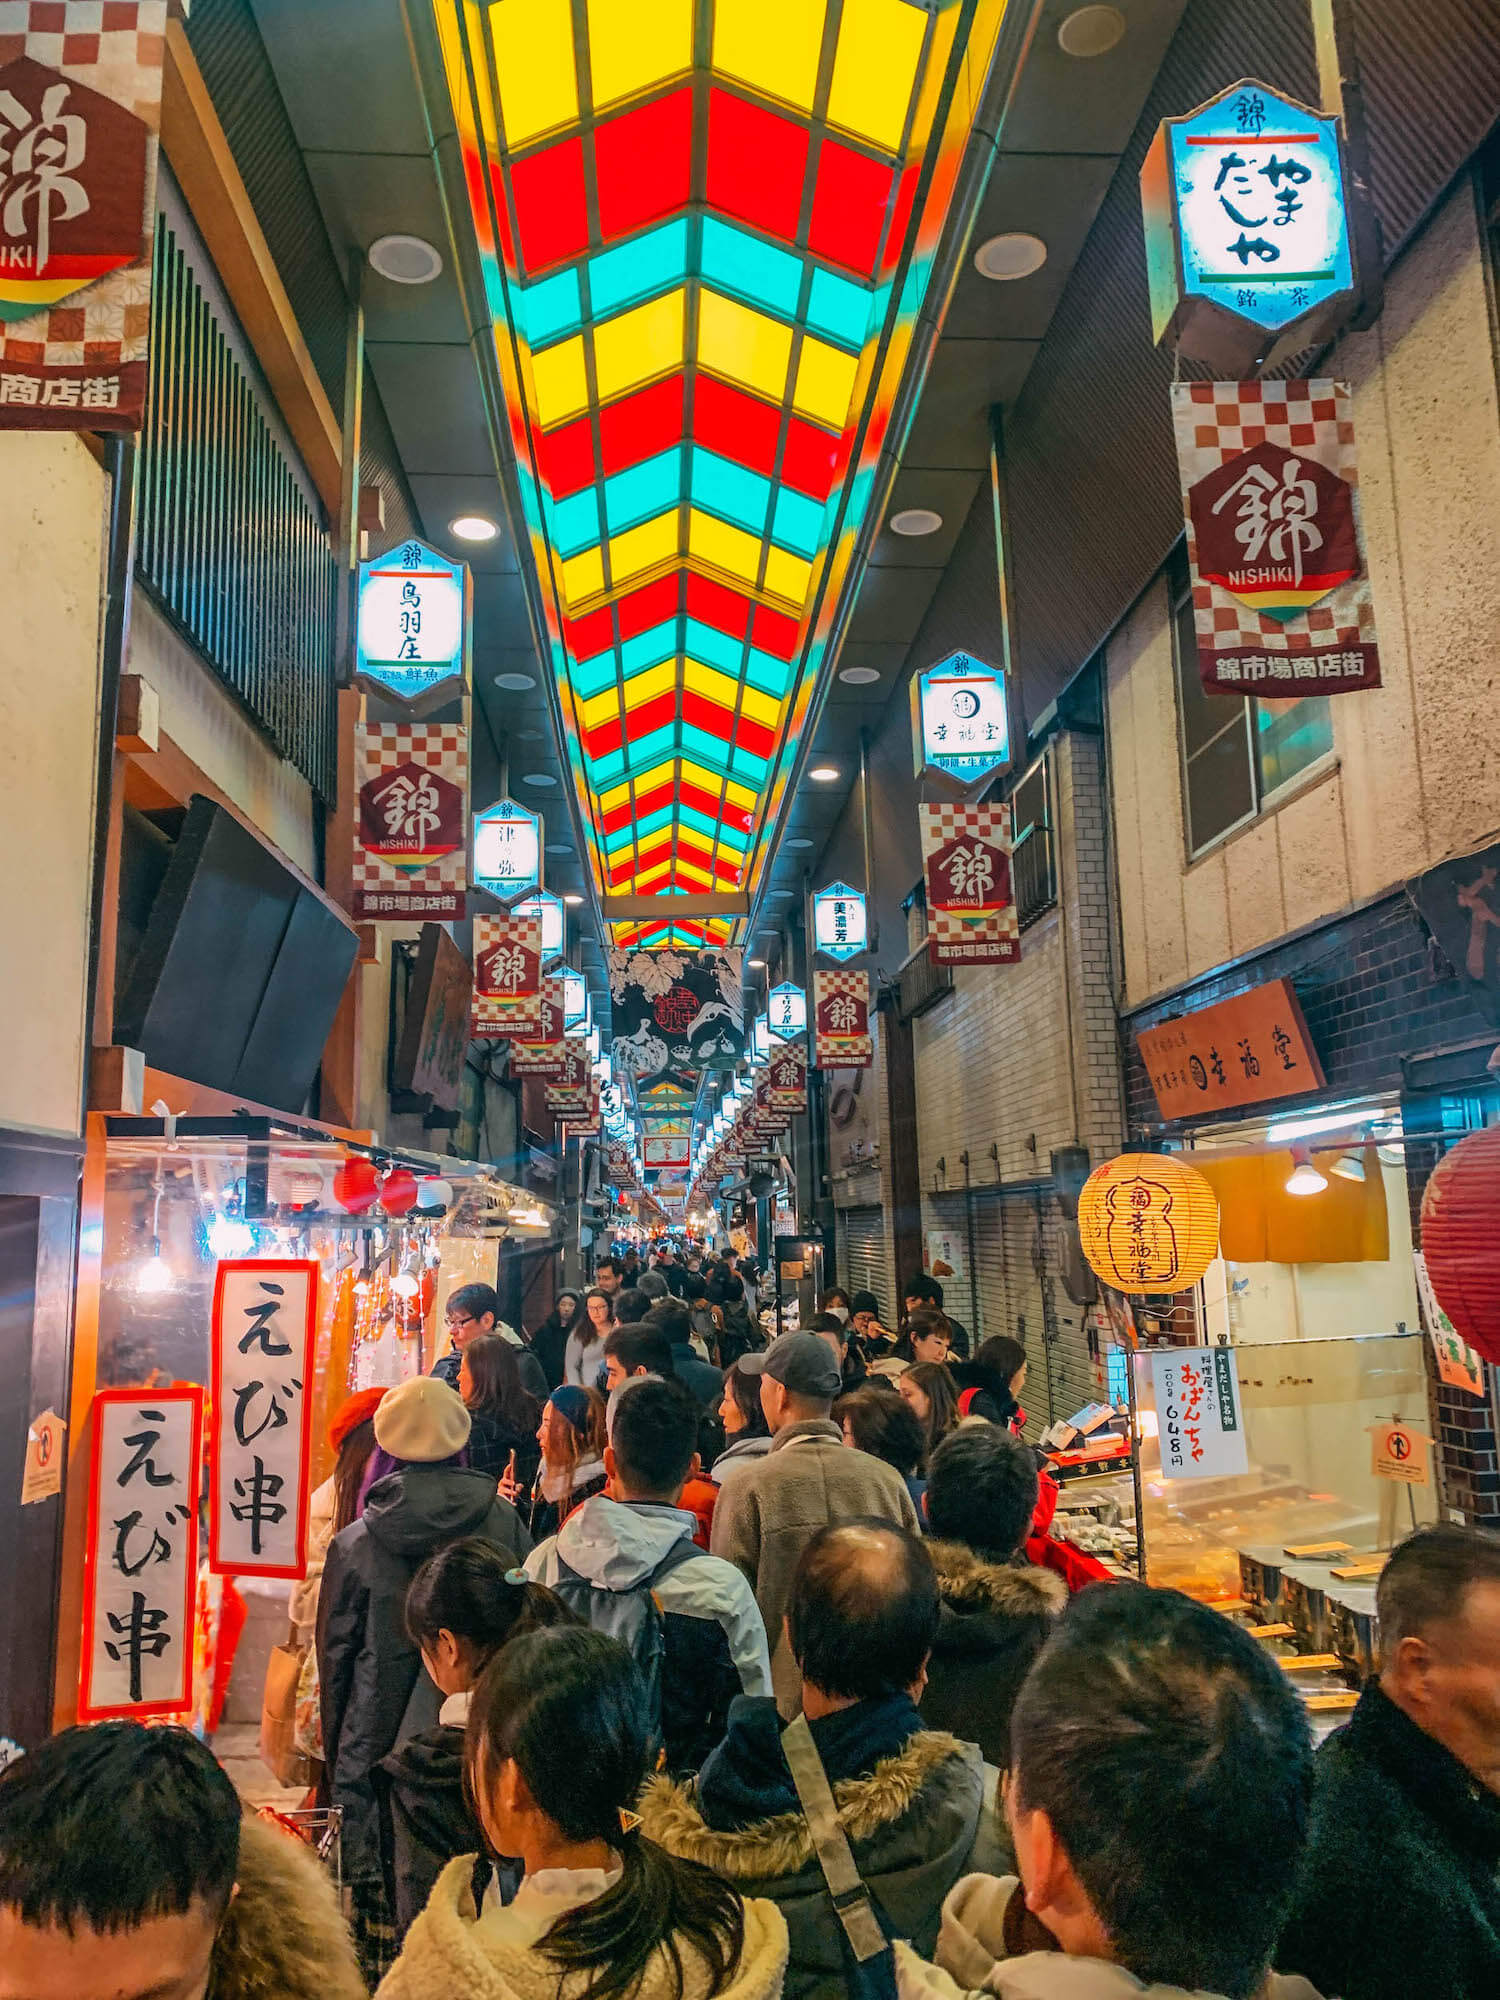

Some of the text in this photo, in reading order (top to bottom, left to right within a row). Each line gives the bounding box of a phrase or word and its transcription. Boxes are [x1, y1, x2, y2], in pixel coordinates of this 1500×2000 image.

[1229, 93, 1266, 138] 錦
[1258, 154, 1312, 226] やま
[1211, 459, 1323, 589] 錦
[1228, 567, 1293, 586] NISHIKI
[1215, 651, 1365, 682] 錦市場商店街
[372, 773, 441, 853] 錦
[937, 842, 995, 908] 錦
[484, 945, 527, 996] 錦
[823, 998, 859, 1036] 錦
[1126, 1210, 1152, 1279] 幸福堂
[229, 1282, 303, 1556] えび串
[104, 1410, 192, 1702] えび串
